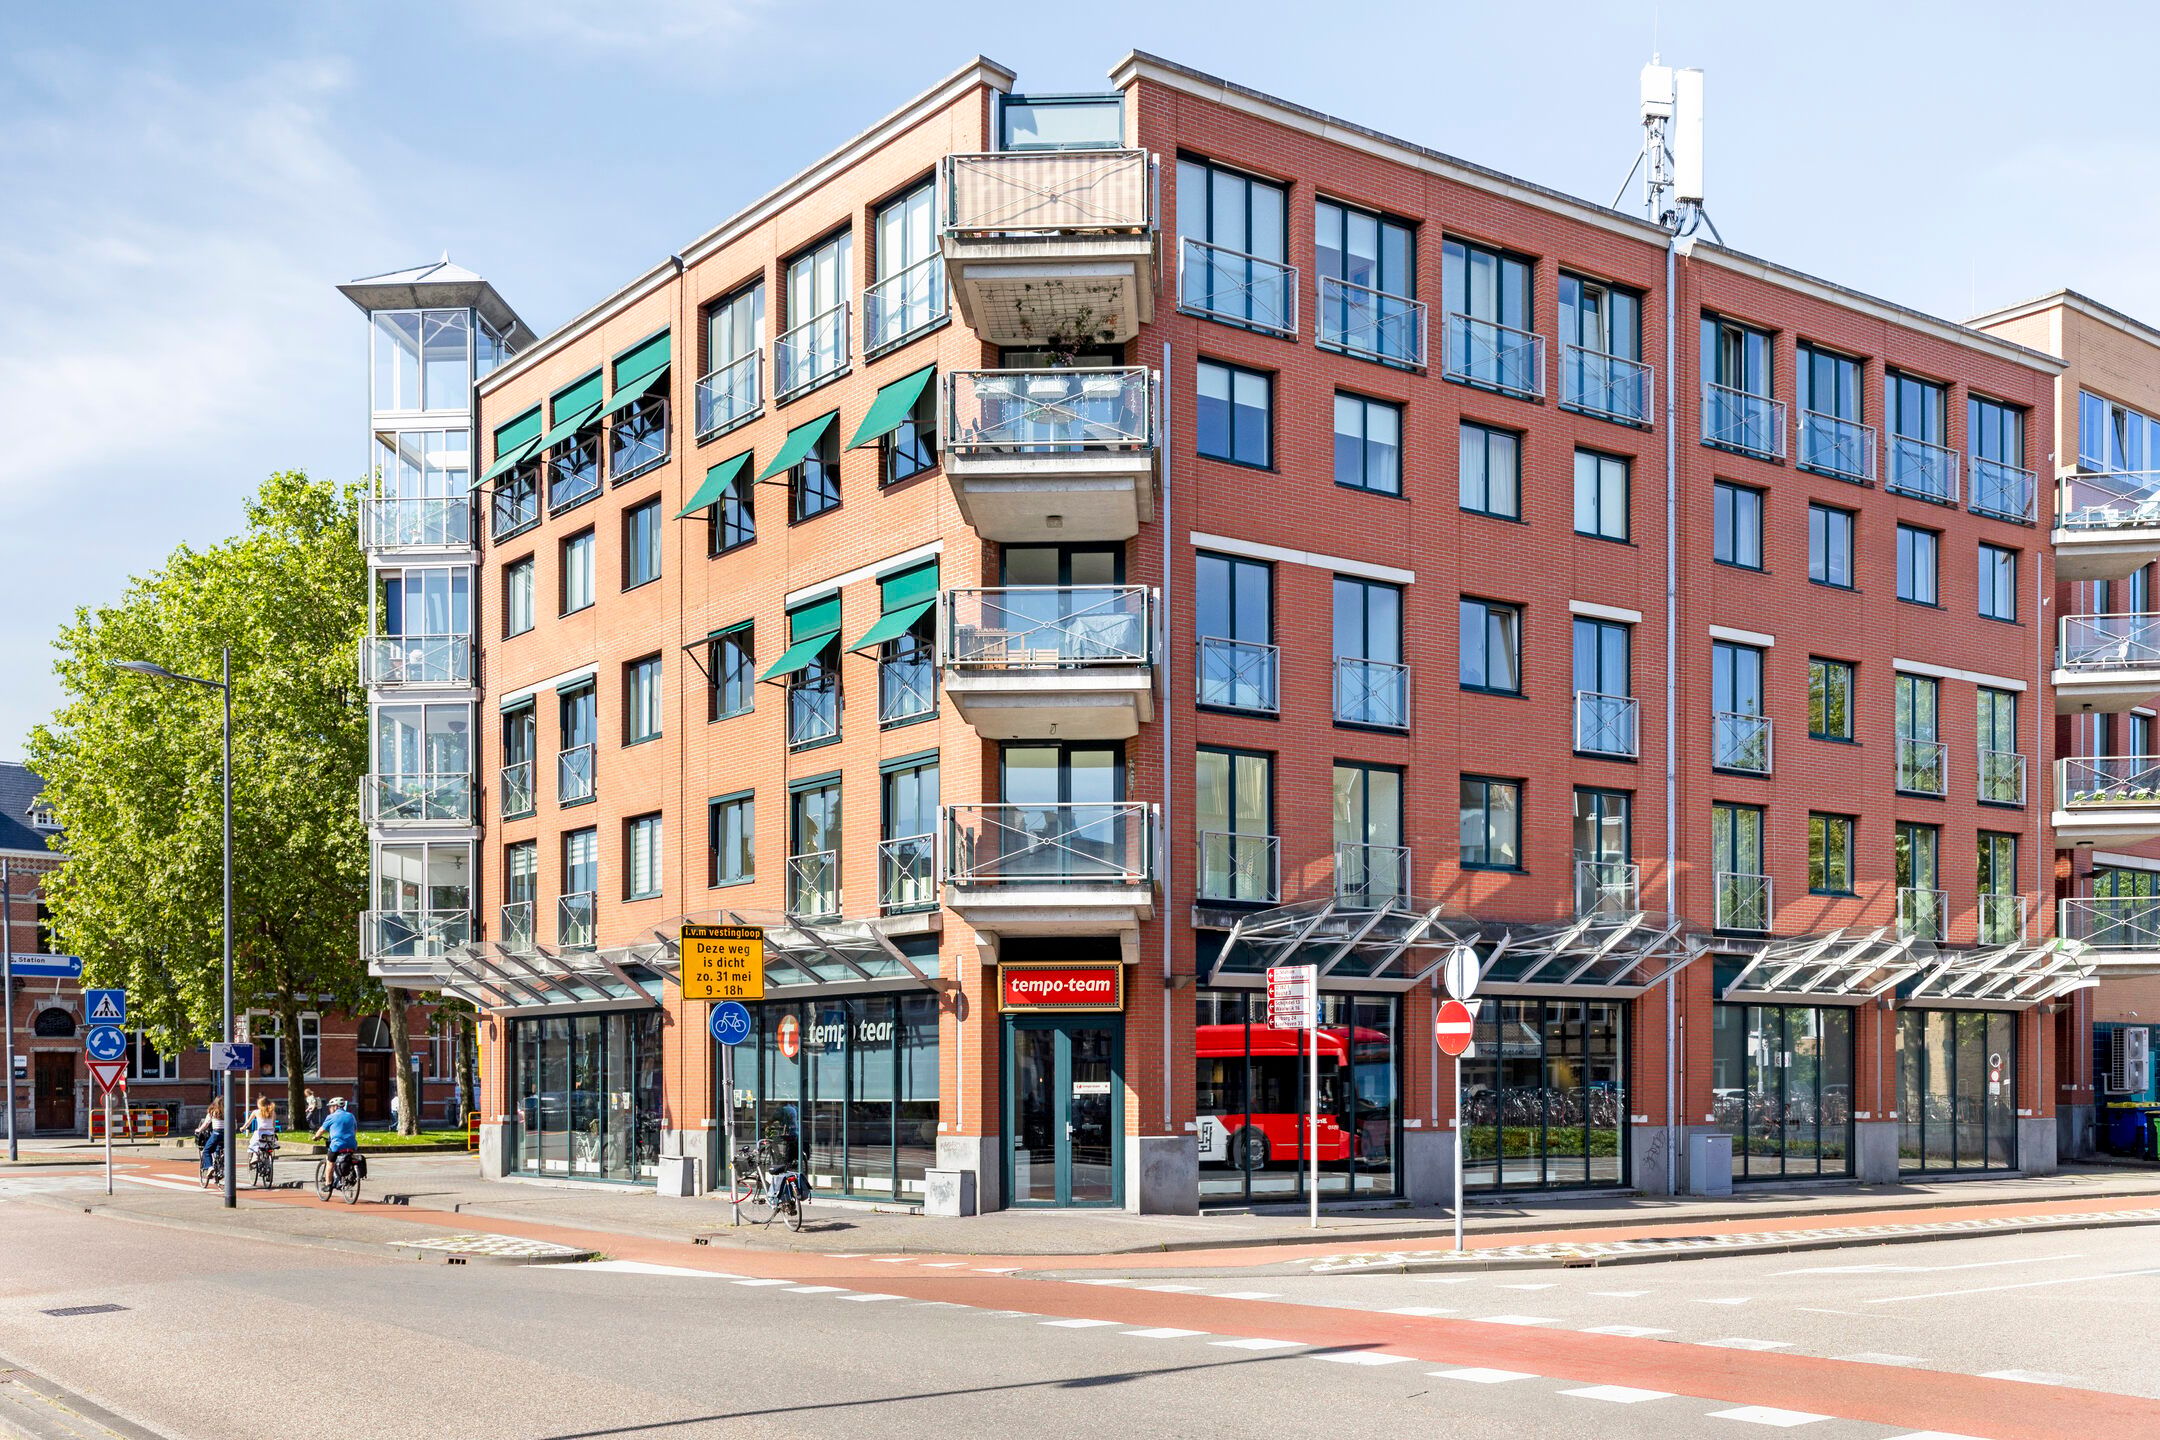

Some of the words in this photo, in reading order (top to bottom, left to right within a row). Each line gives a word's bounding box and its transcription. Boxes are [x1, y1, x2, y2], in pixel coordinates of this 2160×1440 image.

[685, 927, 706, 936] i.v.m
[709, 928, 761, 939] vestingloop
[697, 943, 724, 953] Deze
[728, 945, 750, 956] weg
[18, 956, 46, 964] Station
[703, 957, 713, 967] is
[716, 957, 745, 968] dicht
[696, 972, 713, 982] zo.
[716, 971, 728, 982] 31
[732, 971, 752, 982] mei
[706, 985, 713, 995] 9
[724, 985, 743, 995] 18h
[1011, 978, 1110, 996] tempo-team
[808, 1022, 857, 1050] temp
